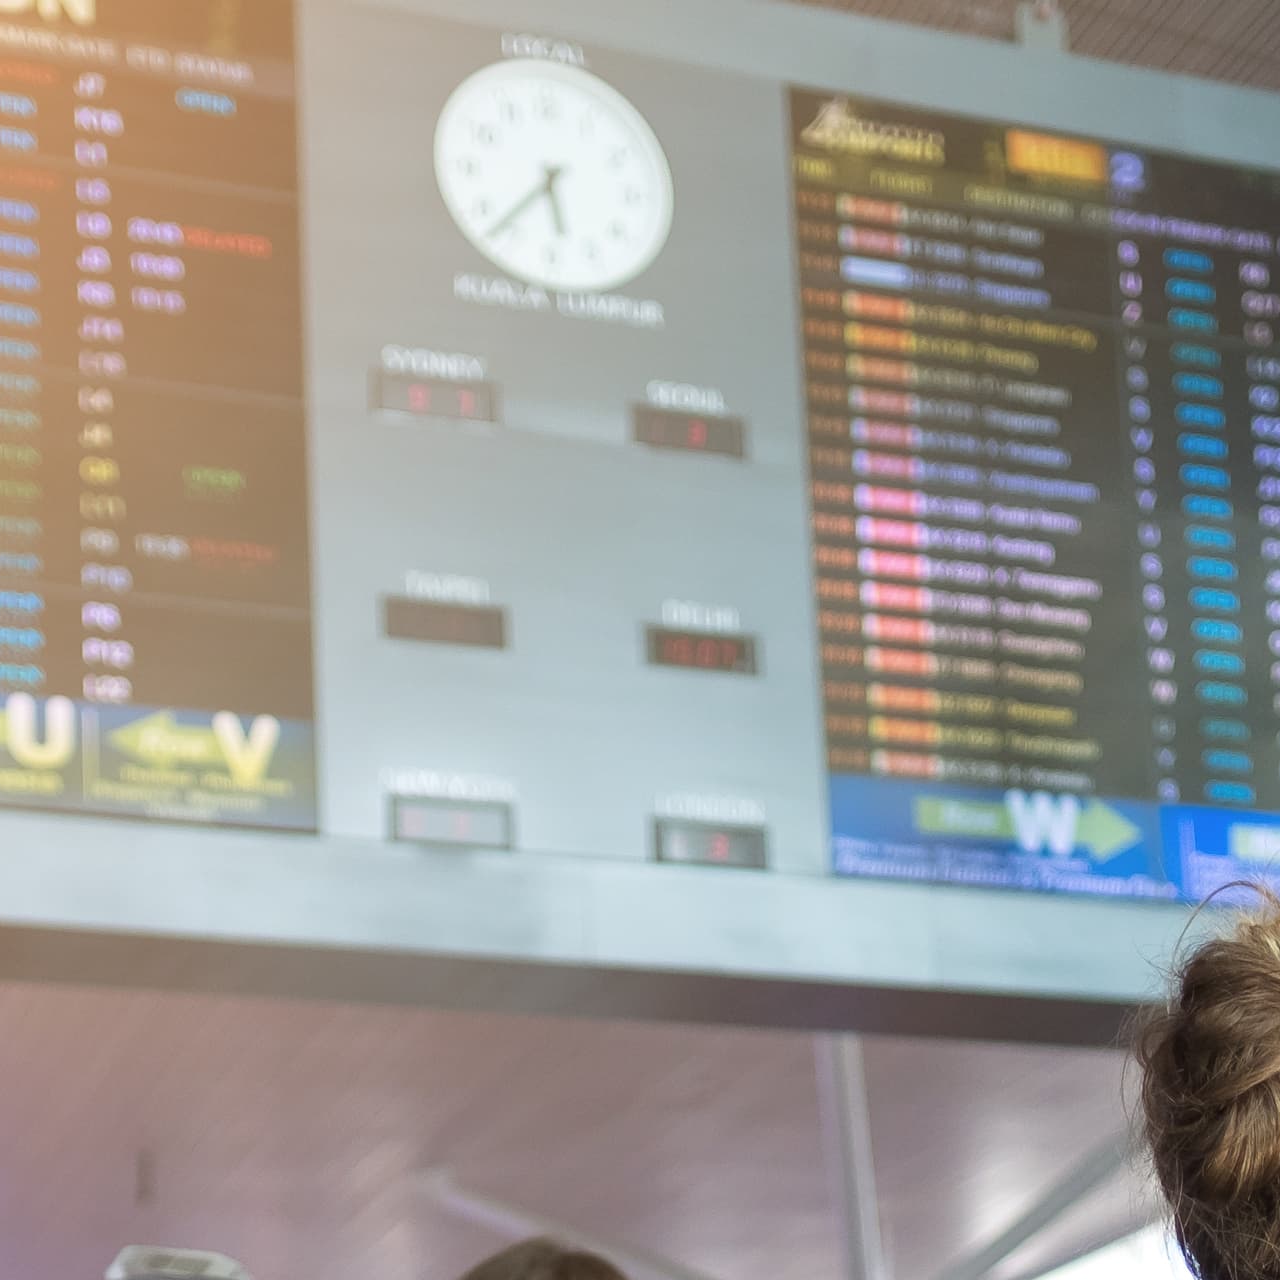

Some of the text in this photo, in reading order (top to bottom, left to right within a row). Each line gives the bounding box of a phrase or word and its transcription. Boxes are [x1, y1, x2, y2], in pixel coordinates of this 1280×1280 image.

[5, 691, 76, 770] U
[211, 711, 280, 788] V
[1004, 788, 1084, 856] W
